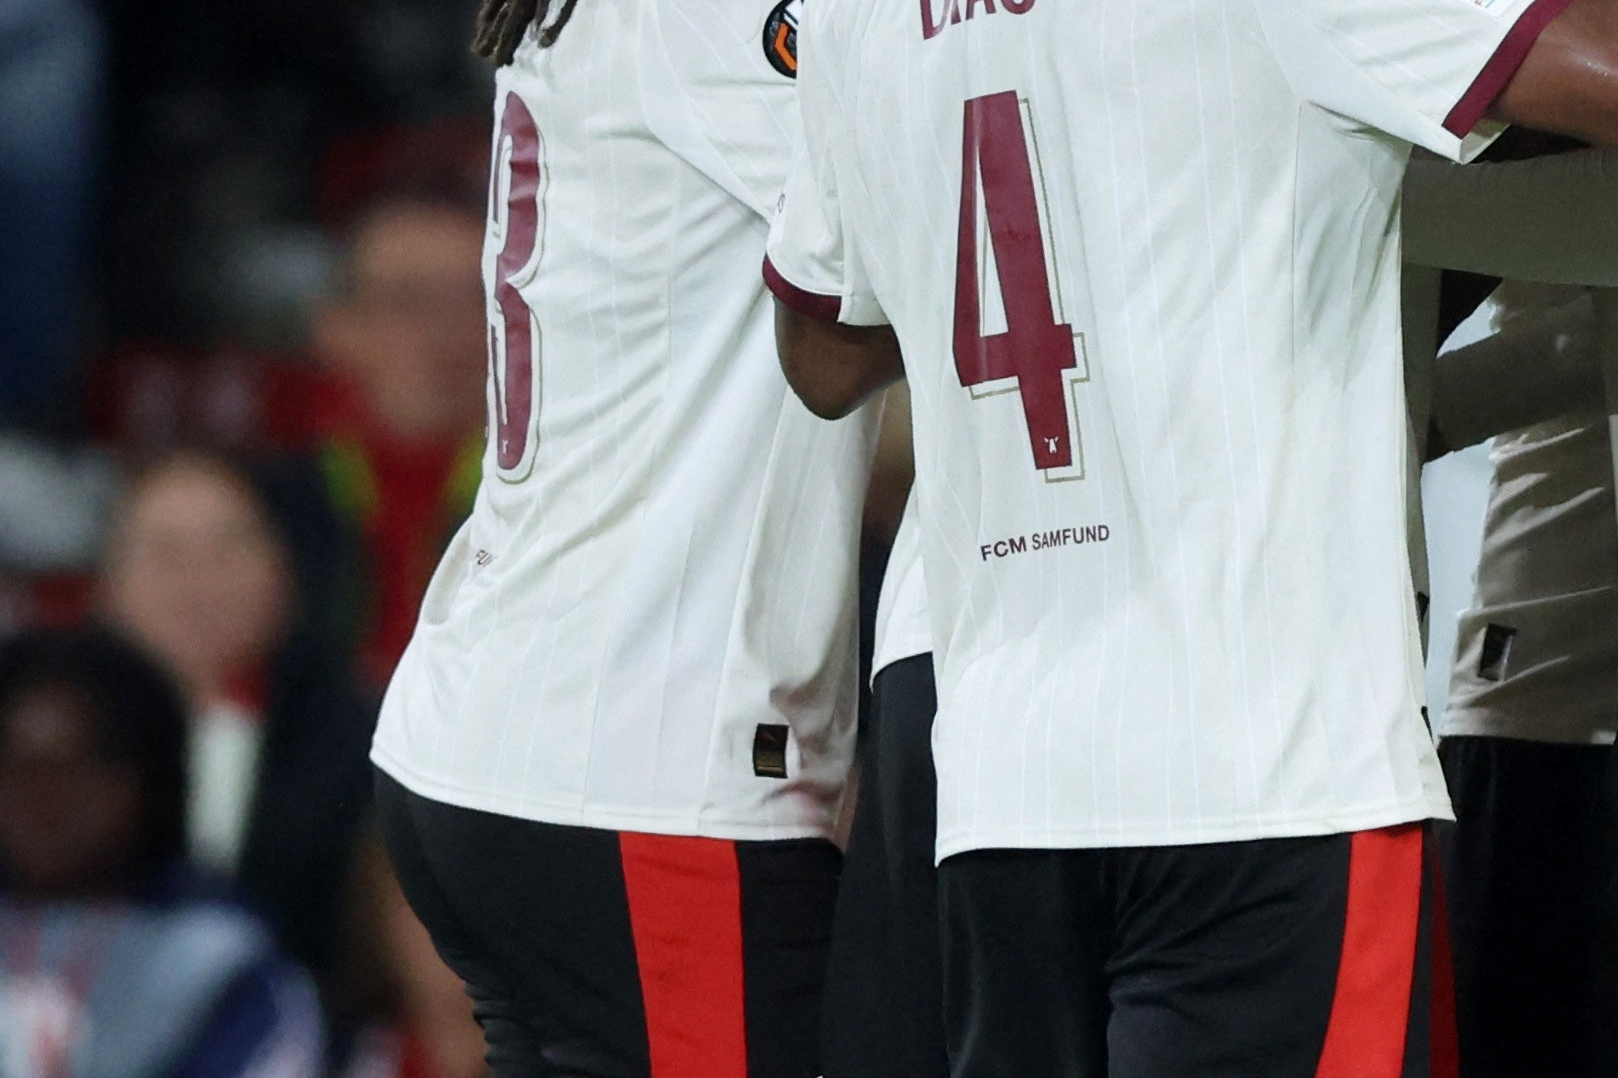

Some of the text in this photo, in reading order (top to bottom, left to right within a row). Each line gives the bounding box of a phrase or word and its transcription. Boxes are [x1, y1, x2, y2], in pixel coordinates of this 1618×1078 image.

[953, 89, 1083, 477] 4
[980, 524, 1110, 562] FCM SAMFUND
